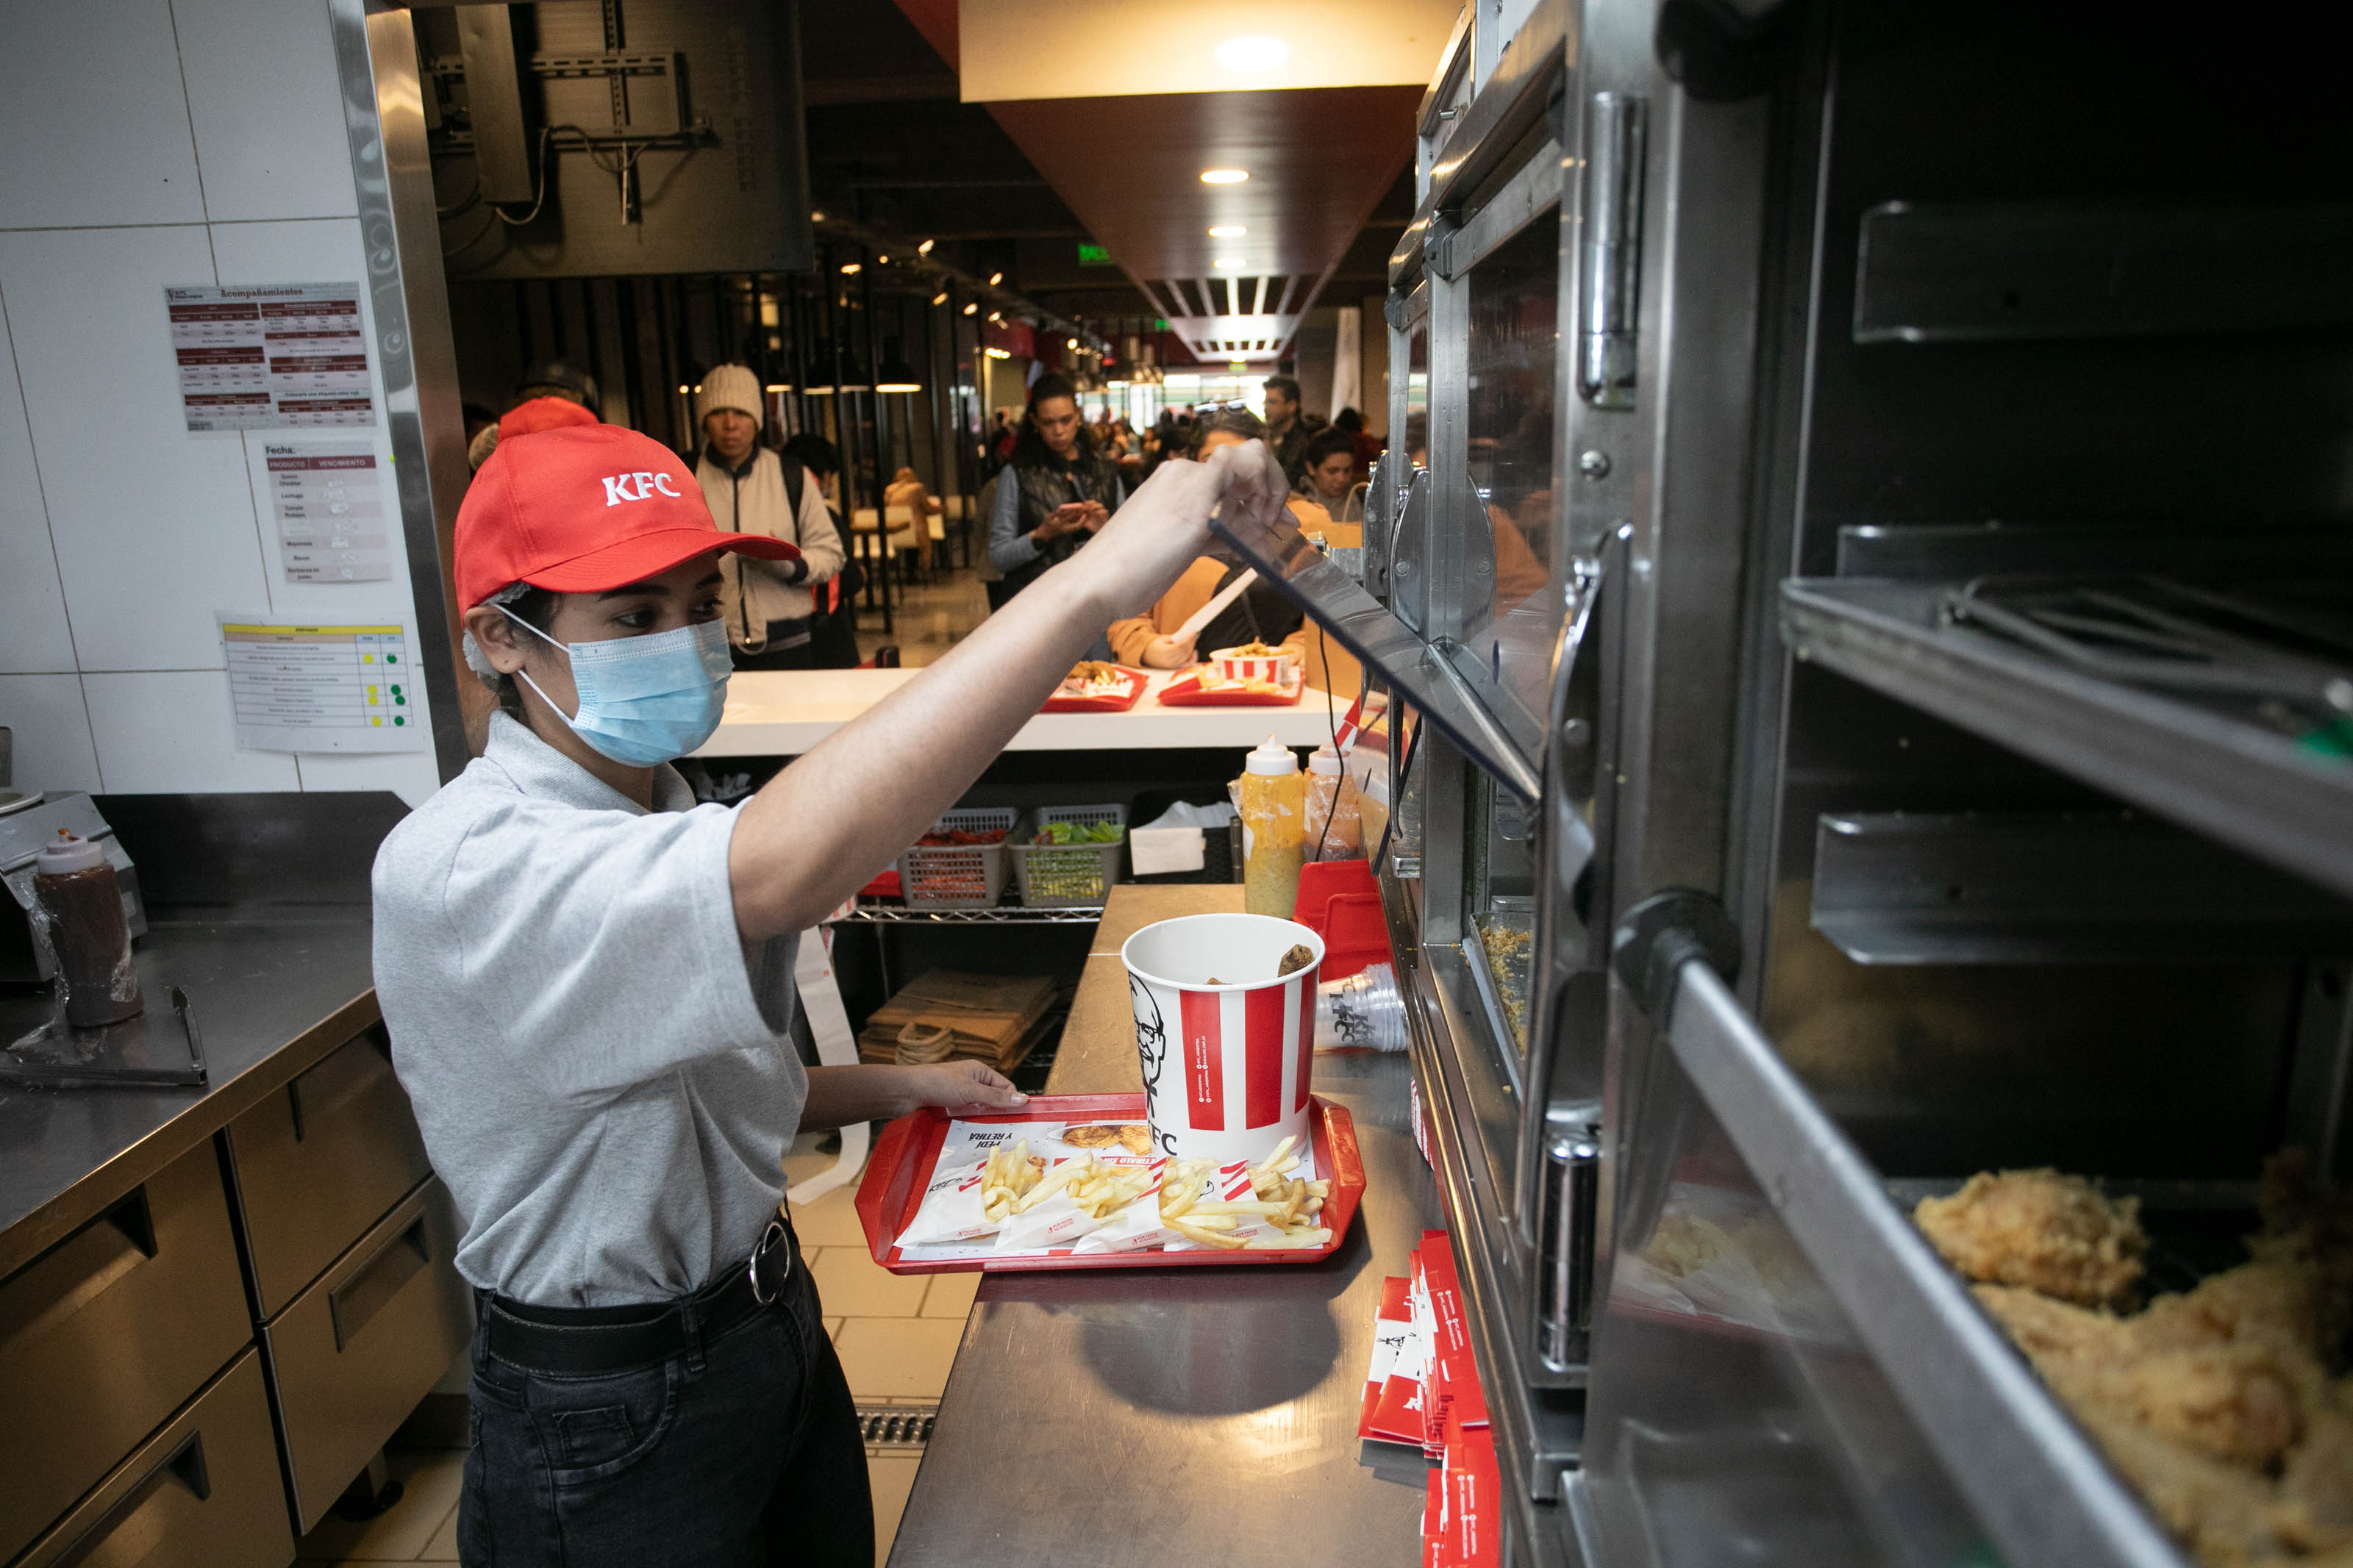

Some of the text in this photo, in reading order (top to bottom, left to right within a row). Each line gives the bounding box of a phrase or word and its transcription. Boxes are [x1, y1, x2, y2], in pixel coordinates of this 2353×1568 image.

[221, 287, 303, 298] Acompañamientos
[265, 445, 295, 454] Fecha:
[269, 459, 365, 468] PRODUCTO VENCIMIENTO
[601, 472, 681, 506] KFC
[1148, 1120, 1176, 1156] FC
